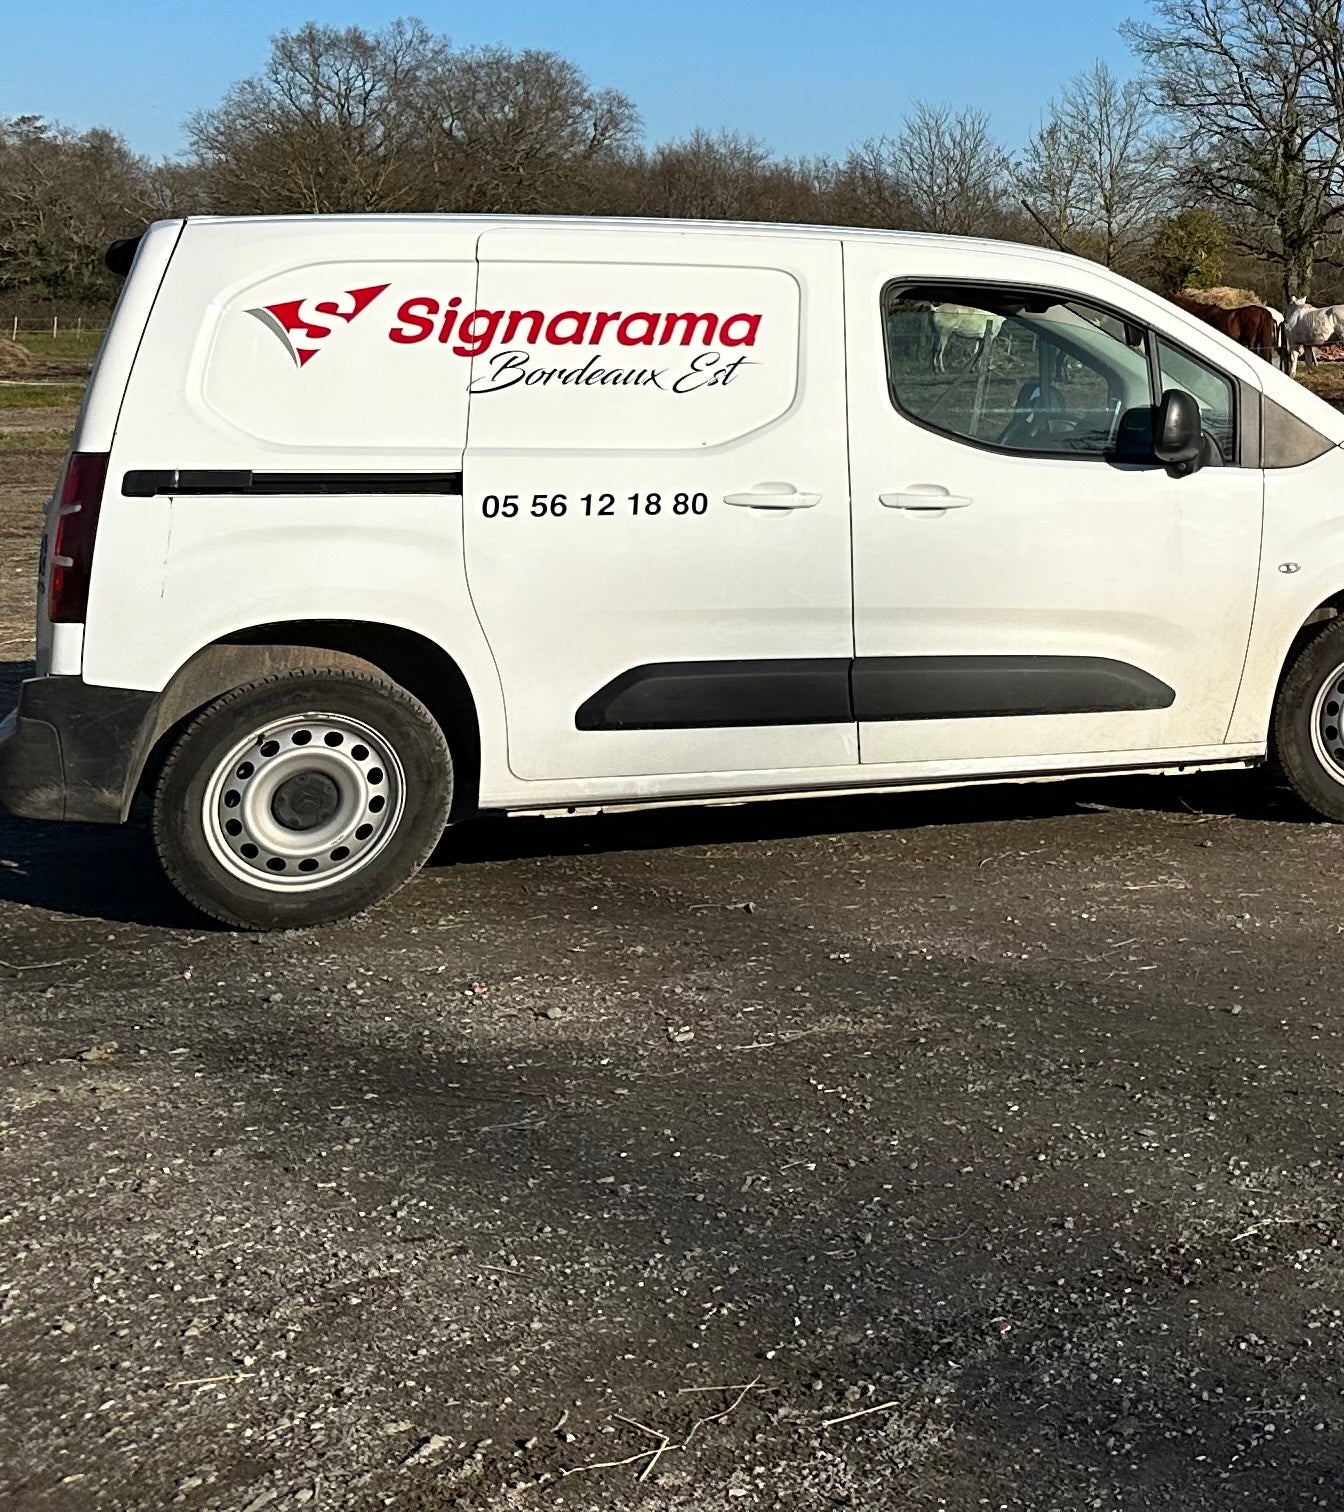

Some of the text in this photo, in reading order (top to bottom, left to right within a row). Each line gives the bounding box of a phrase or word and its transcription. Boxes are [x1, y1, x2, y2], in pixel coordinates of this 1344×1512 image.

[388, 296, 763, 358] Signarama
[466, 349, 766, 394] Bordeaux Est
[481, 492, 709, 519] 05 56 12 18 80
